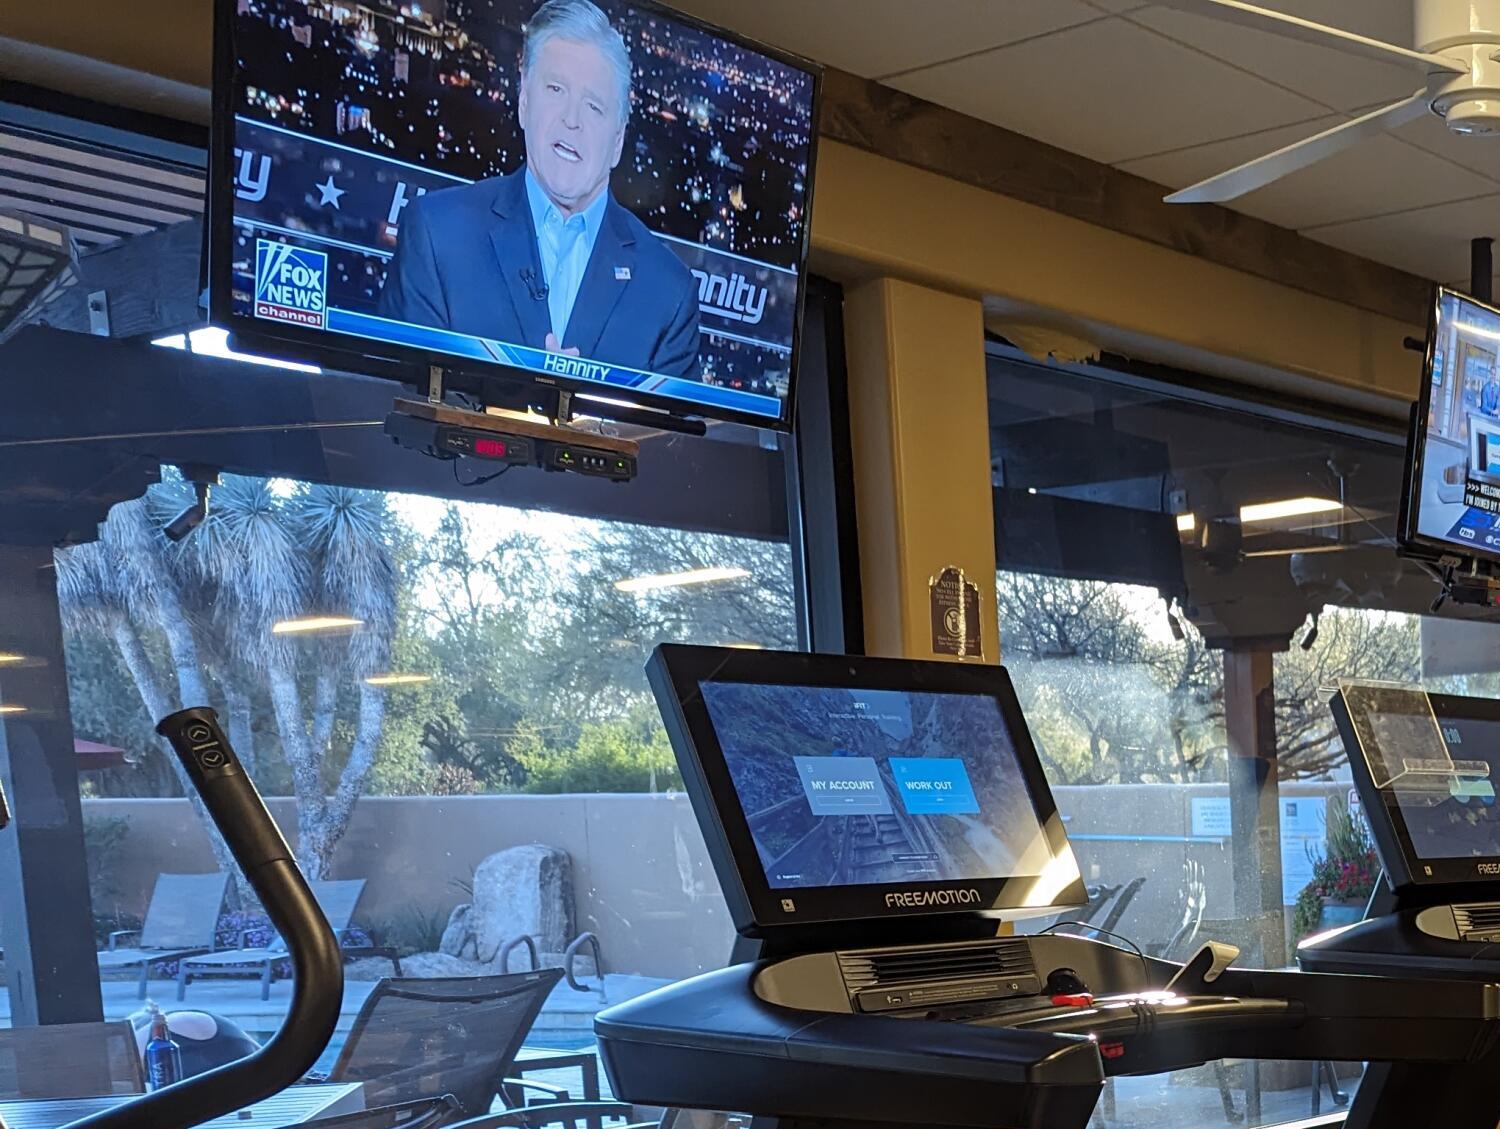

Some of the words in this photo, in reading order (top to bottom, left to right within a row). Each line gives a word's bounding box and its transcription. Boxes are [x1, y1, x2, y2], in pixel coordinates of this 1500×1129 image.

[280, 263, 322, 289] FOX
[267, 284, 322, 311] NEWS
[258, 303, 322, 325] channel
[811, 780, 826, 790] MY
[829, 780, 875, 790] ACCOUNT
[905, 780, 933, 790] WORK
[934, 780, 952, 790] OUT
[884, 888, 982, 908] FREEMOTION
